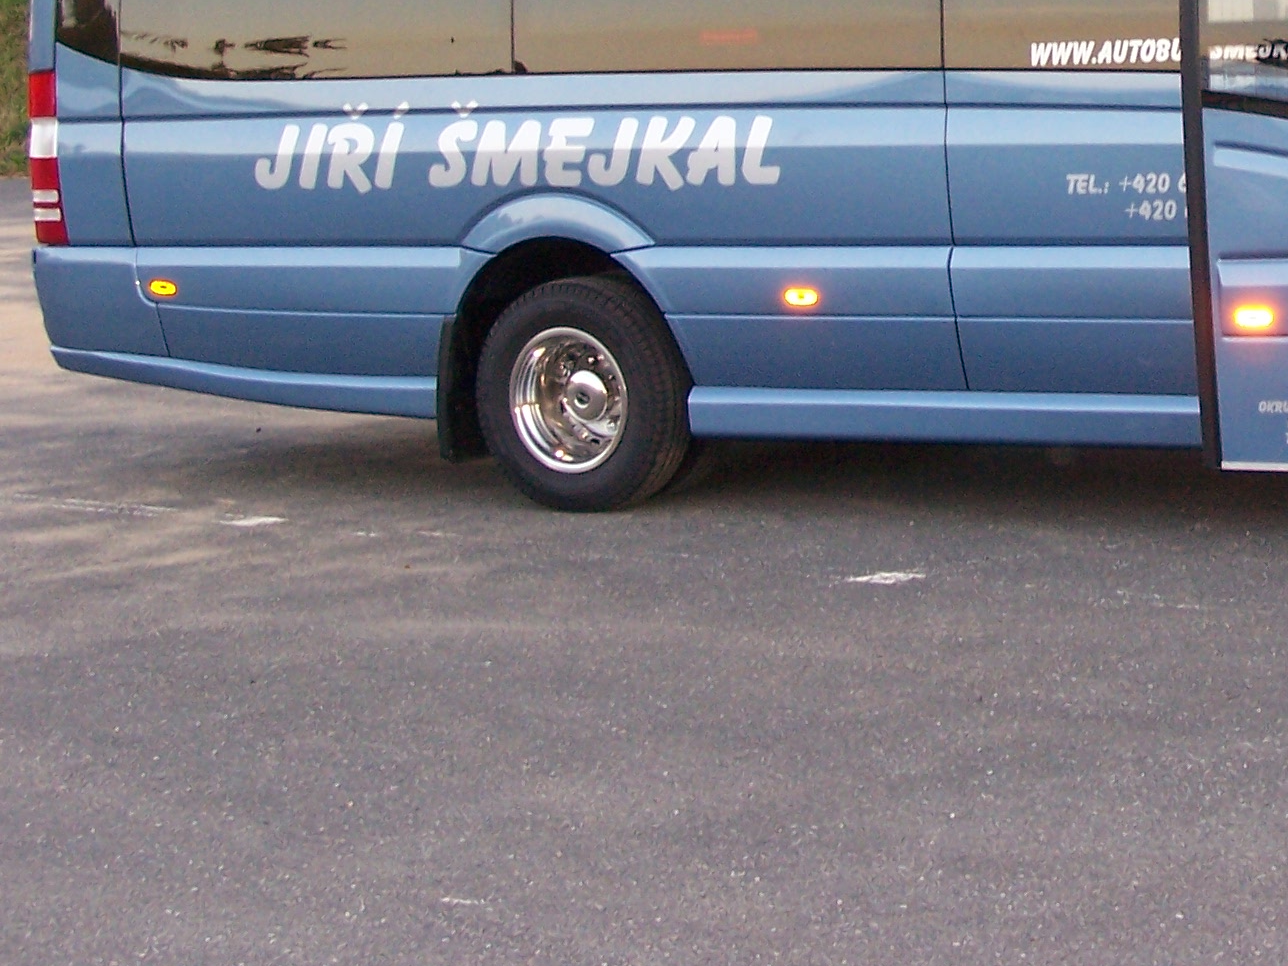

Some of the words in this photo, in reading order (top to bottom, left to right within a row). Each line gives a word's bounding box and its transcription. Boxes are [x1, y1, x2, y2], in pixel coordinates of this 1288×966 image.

[255, 101, 409, 193] JIŘÍ
[428, 100, 781, 191] ŠMEJKAL
[1119, 172, 1170, 194] +420
[1124, 199, 1177, 221] +420
